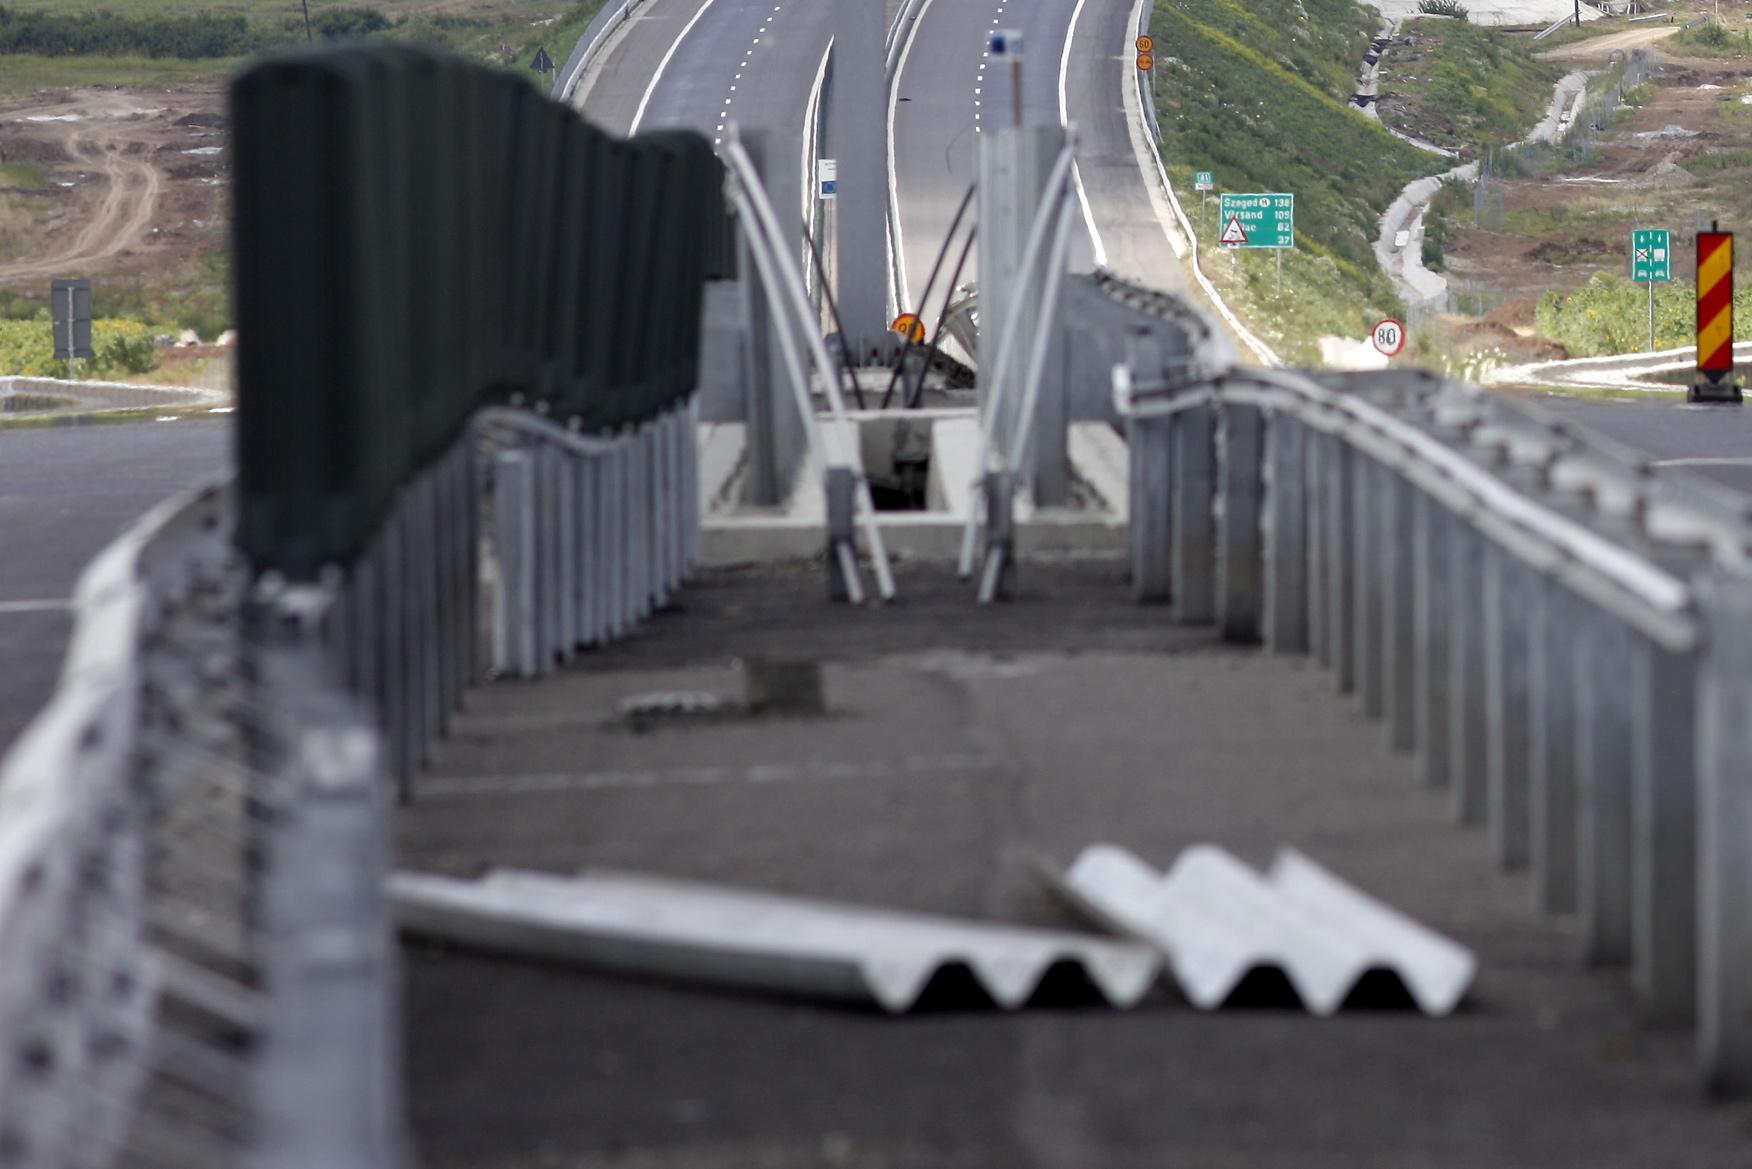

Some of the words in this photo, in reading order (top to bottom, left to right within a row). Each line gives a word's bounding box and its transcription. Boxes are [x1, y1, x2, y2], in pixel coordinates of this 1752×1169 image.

[1139, 39, 1149, 49] 60
[1223, 197, 1258, 209] Szeged
[1274, 198, 1290, 207] 138
[1378, 328, 1396, 346] 80
